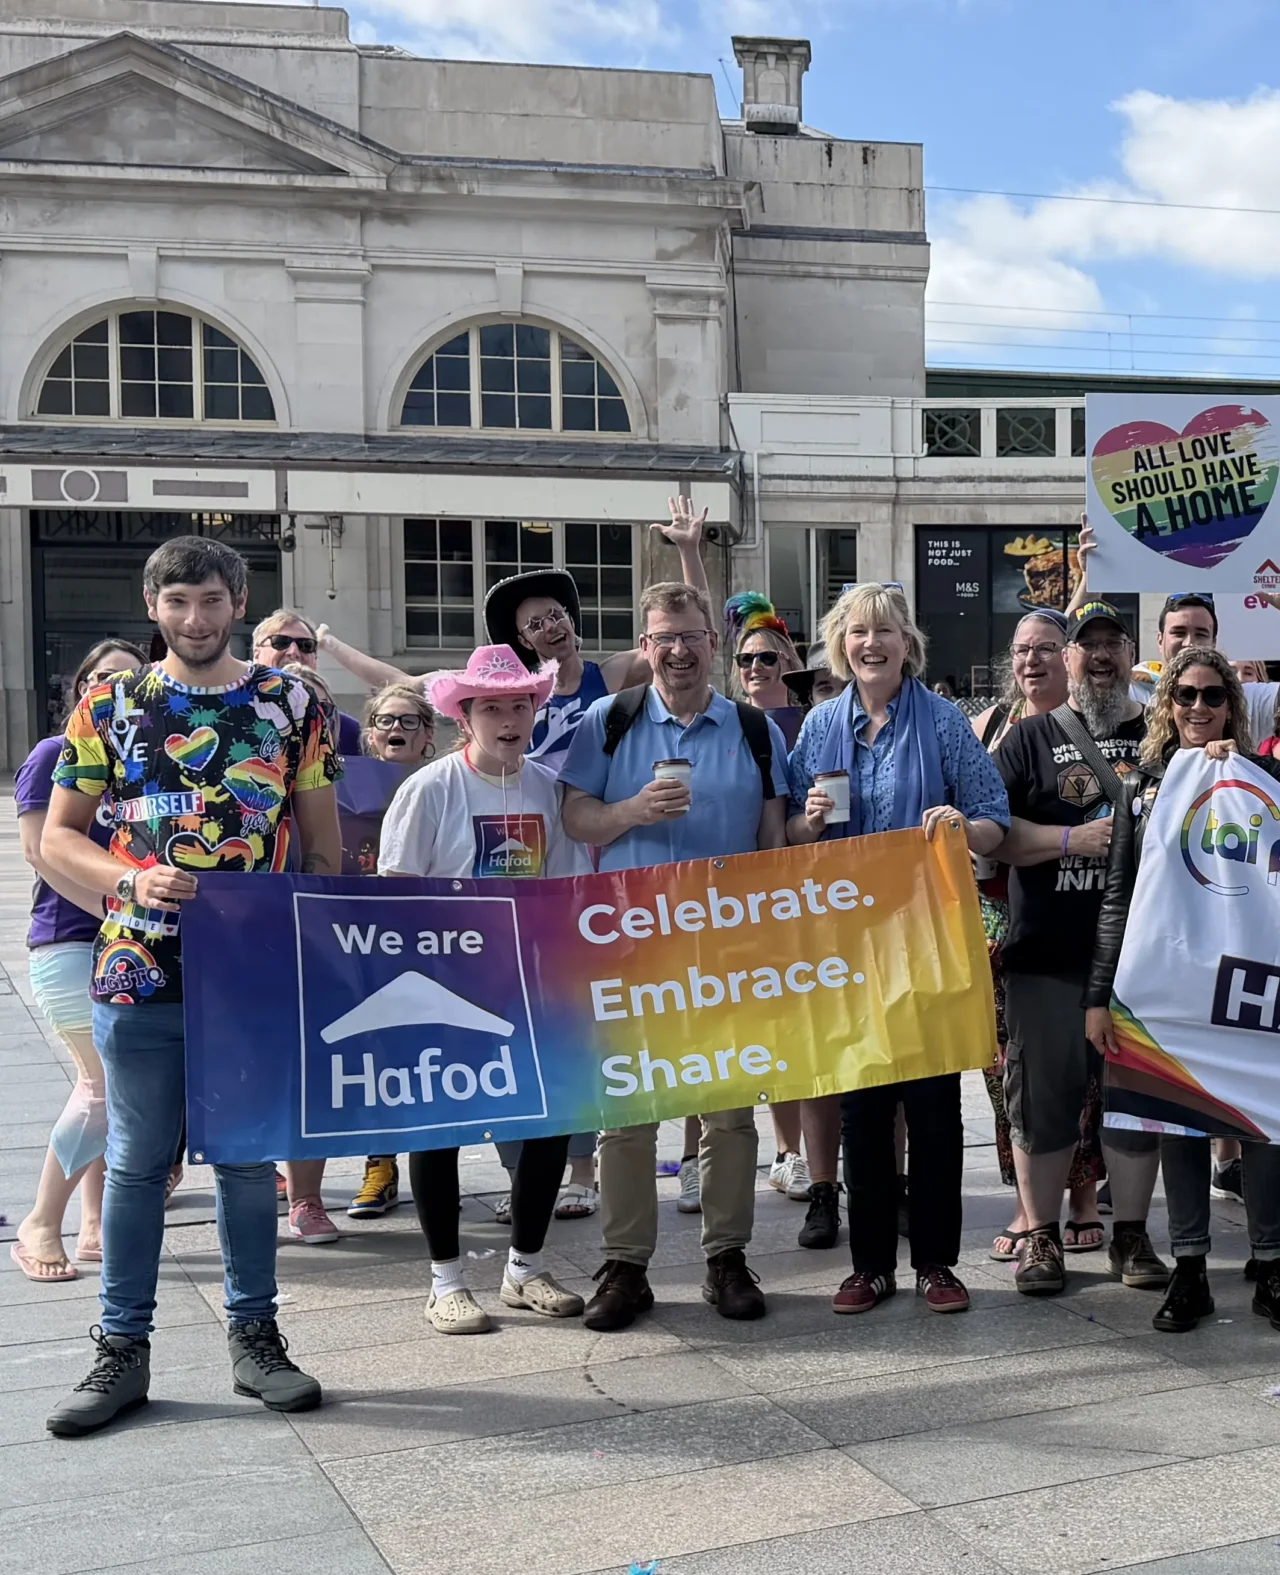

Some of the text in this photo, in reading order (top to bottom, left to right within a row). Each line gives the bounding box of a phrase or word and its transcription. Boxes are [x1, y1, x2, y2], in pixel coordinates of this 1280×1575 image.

[1133, 431, 1236, 474] ALL LOVE
[1111, 453, 1262, 504] SHOULD HAVE
[1135, 479, 1263, 540] A HOME
[956, 582, 980, 593] M&S
[259, 728, 280, 761] be
[1052, 739, 1138, 755] WHE MEONE
[1053, 751, 1083, 764] ONE
[1101, 747, 1127, 759] RTY
[123, 792, 203, 821] YOURSELF
[1200, 808, 1263, 864] tai
[489, 853, 531, 867] Hafod
[1059, 856, 1083, 869] WE
[578, 877, 875, 944] Celebrate.
[332, 923, 484, 955] We are
[95, 965, 166, 995] LGBTQ
[590, 956, 865, 1021] Embrace.
[331, 1045, 518, 1109] Hafod
[601, 1043, 788, 1097] Share.
